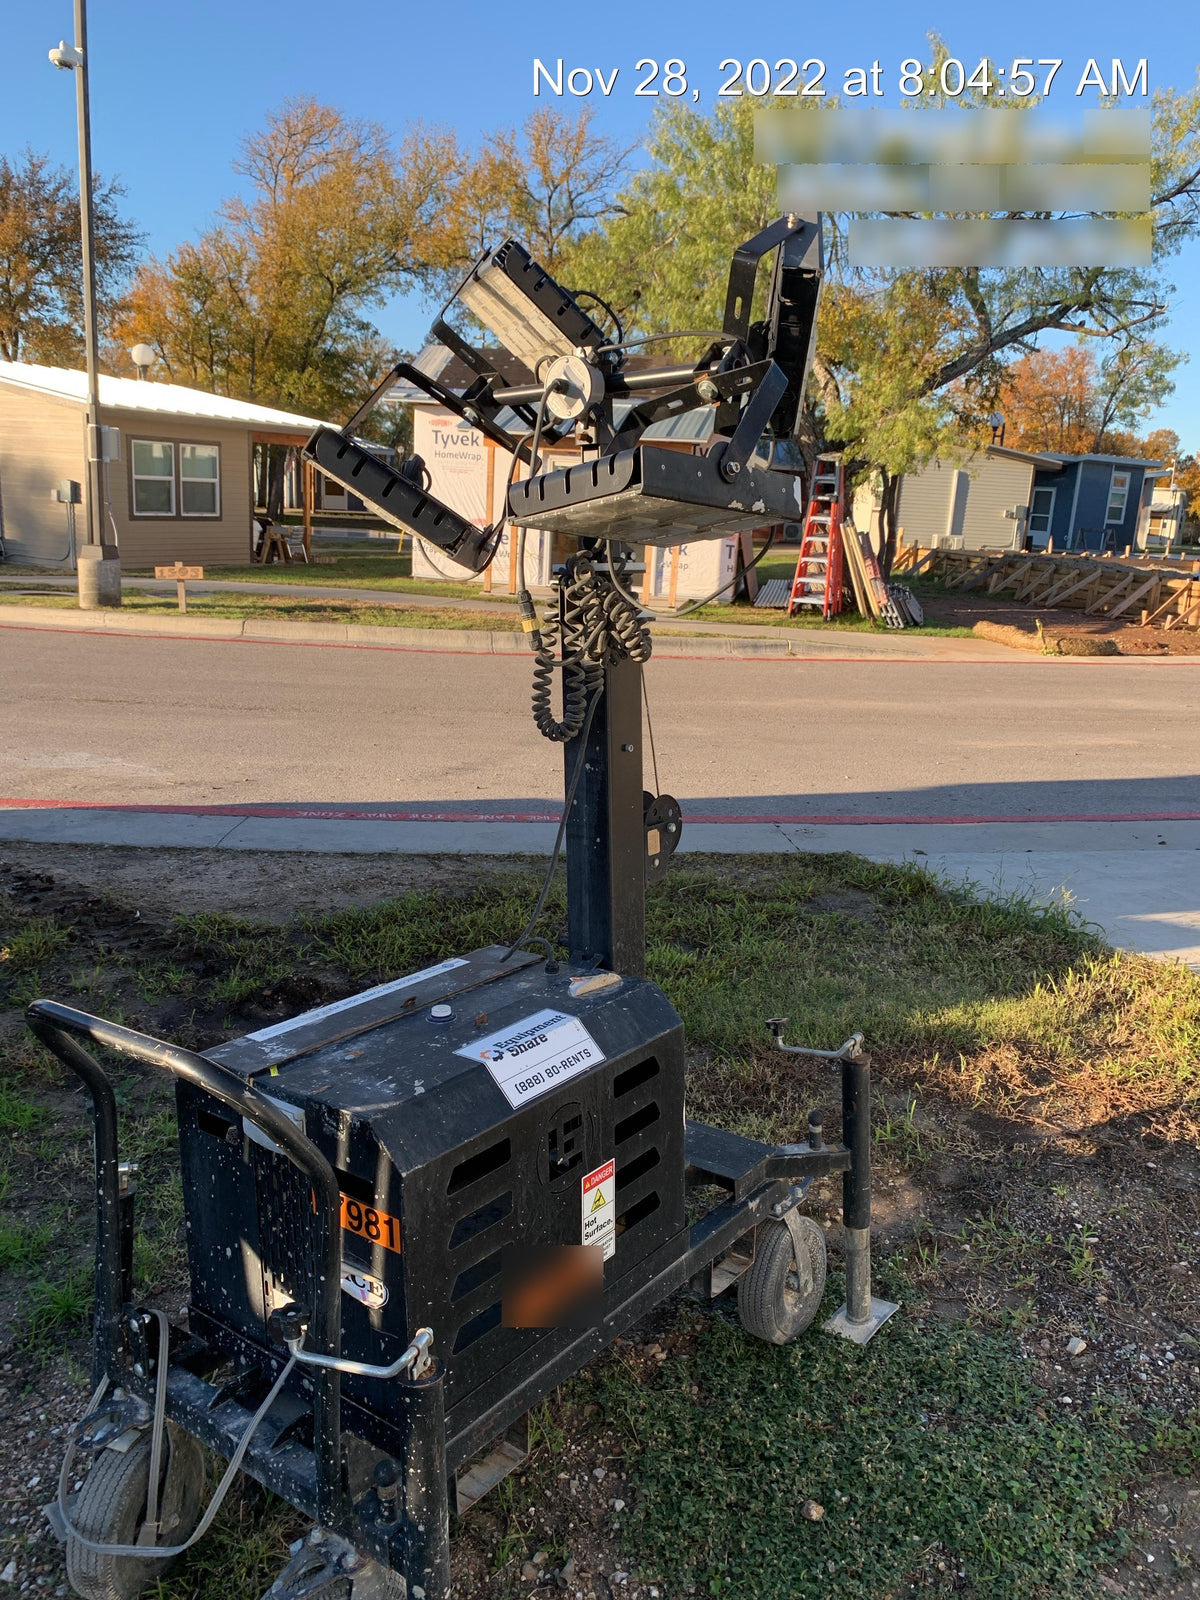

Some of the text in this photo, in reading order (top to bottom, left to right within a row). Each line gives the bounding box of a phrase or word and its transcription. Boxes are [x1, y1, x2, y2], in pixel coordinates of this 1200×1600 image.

[432, 430, 480, 448] Tyvek
[493, 1013, 567, 1049] Equipment
[506, 1032, 549, 1058] Share
[514, 1048, 592, 1095] (888) 80-RENTS
[590, 1165, 613, 1186] DANGER
[340, 1198, 395, 1249] 981
[584, 1216, 597, 1231] Hot
